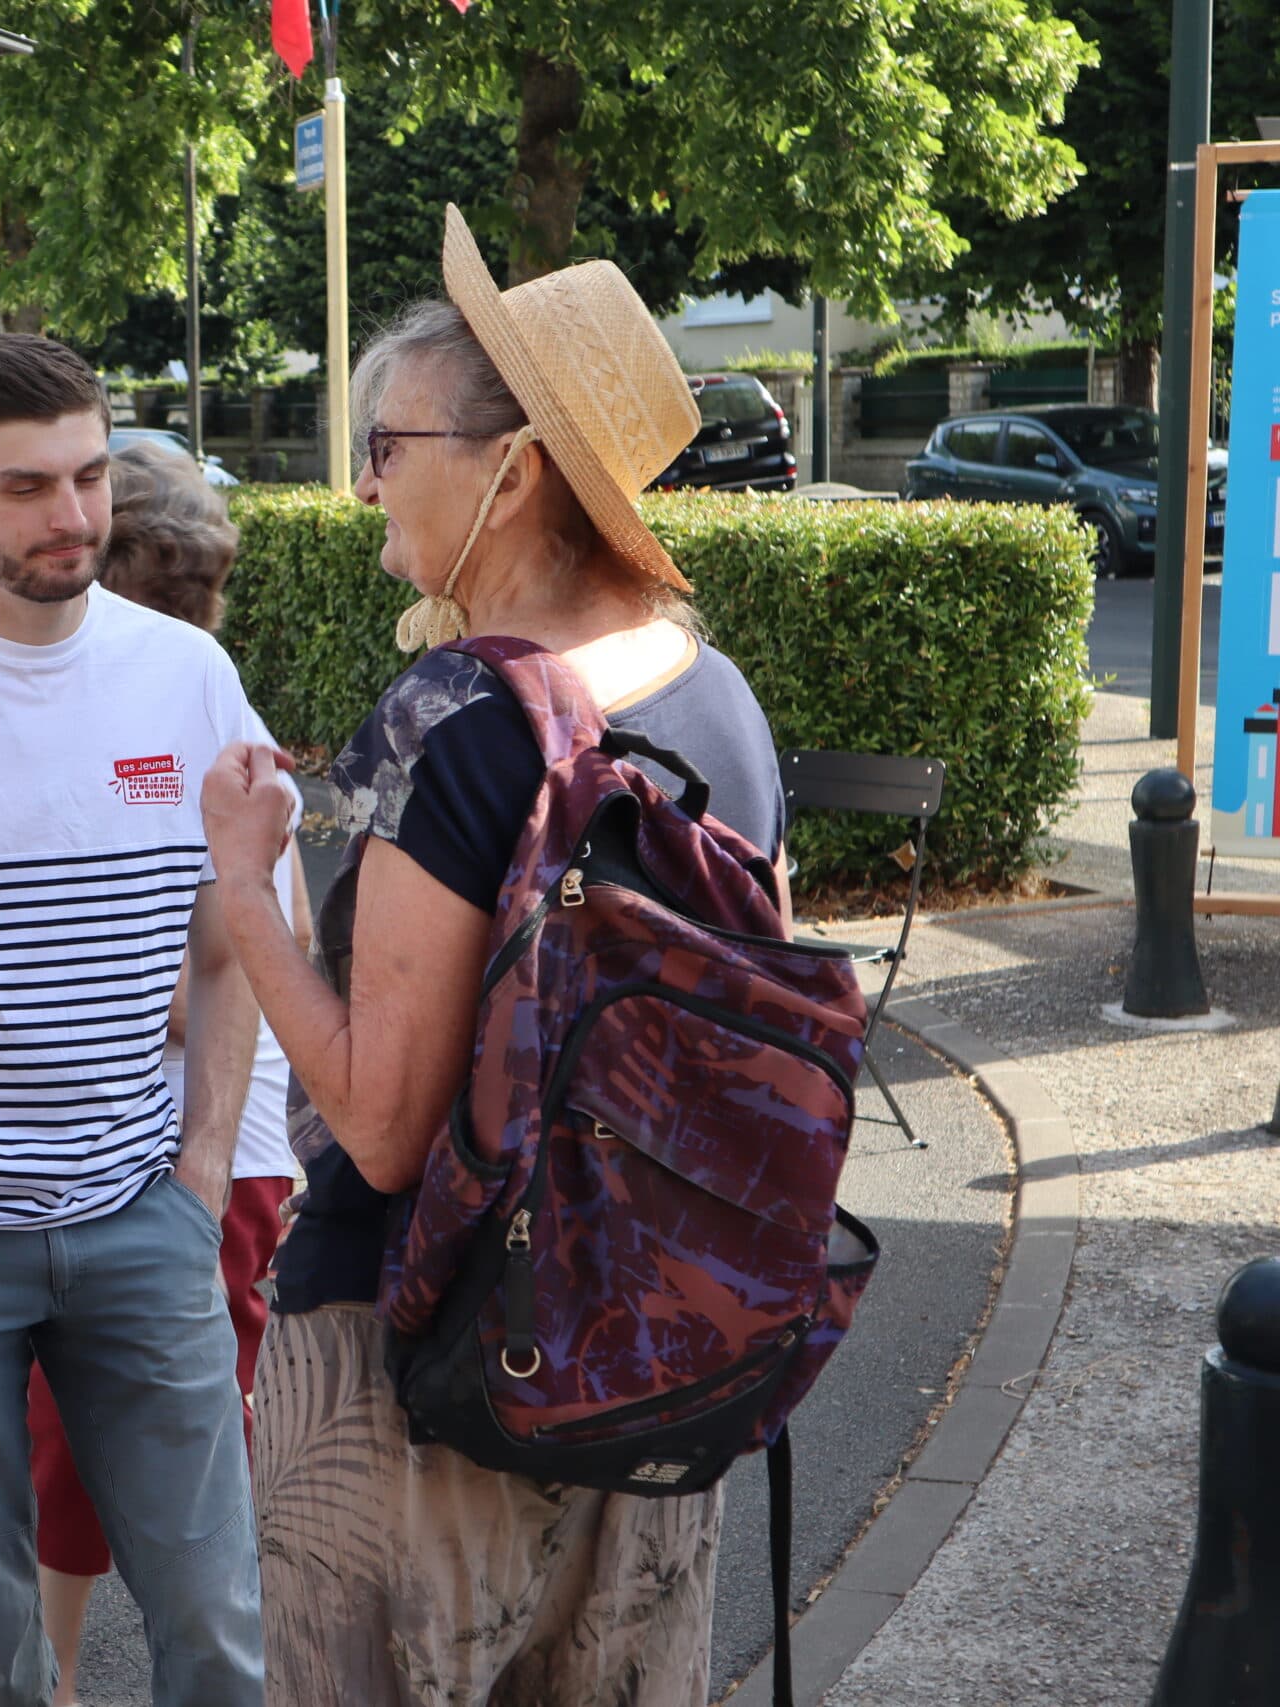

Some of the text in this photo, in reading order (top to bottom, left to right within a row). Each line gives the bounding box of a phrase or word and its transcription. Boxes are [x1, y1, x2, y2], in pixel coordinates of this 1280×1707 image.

[117, 760, 172, 773] Les Jeunes
[129, 791, 142, 799] LA
